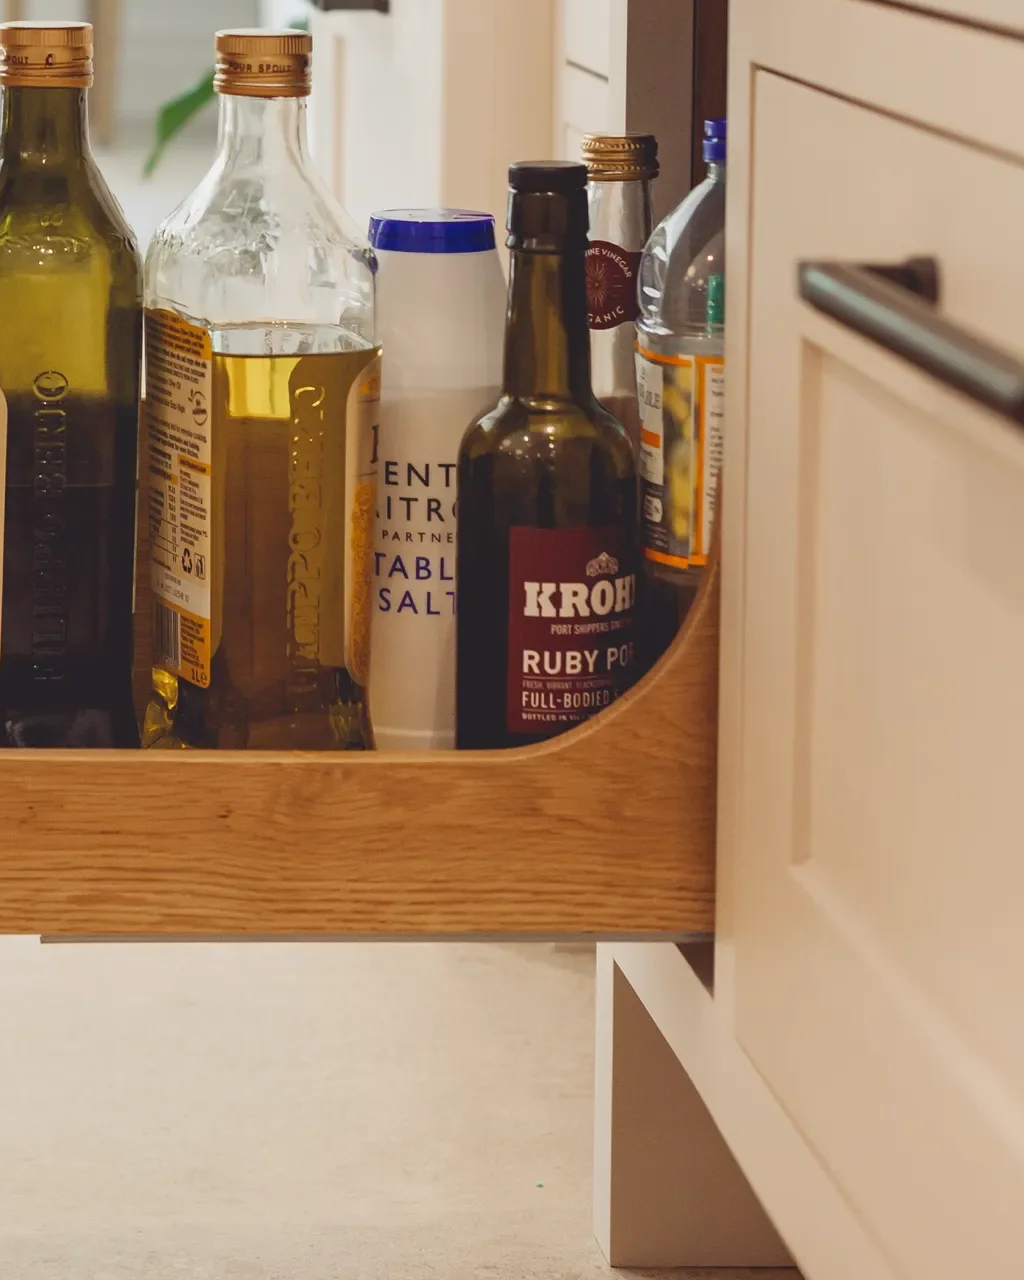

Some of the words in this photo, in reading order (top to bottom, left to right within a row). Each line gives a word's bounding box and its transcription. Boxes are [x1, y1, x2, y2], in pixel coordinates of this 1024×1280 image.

[258, 63, 293, 74] SPOUT
[601, 248, 633, 278] VINEGAR
[588, 305, 624, 324] GANIC
[384, 461, 457, 488] ENT
[376, 495, 457, 522] ITR
[381, 529, 454, 544] PARTNE
[374, 552, 454, 581] TABL
[551, 623, 573, 635] PORT
[574, 621, 610, 635] SHIPPERS
[522, 649, 600, 675] RUBY
[521, 690, 610, 709] FULL-BODIED
[521, 712, 557, 722] BOTTLED
